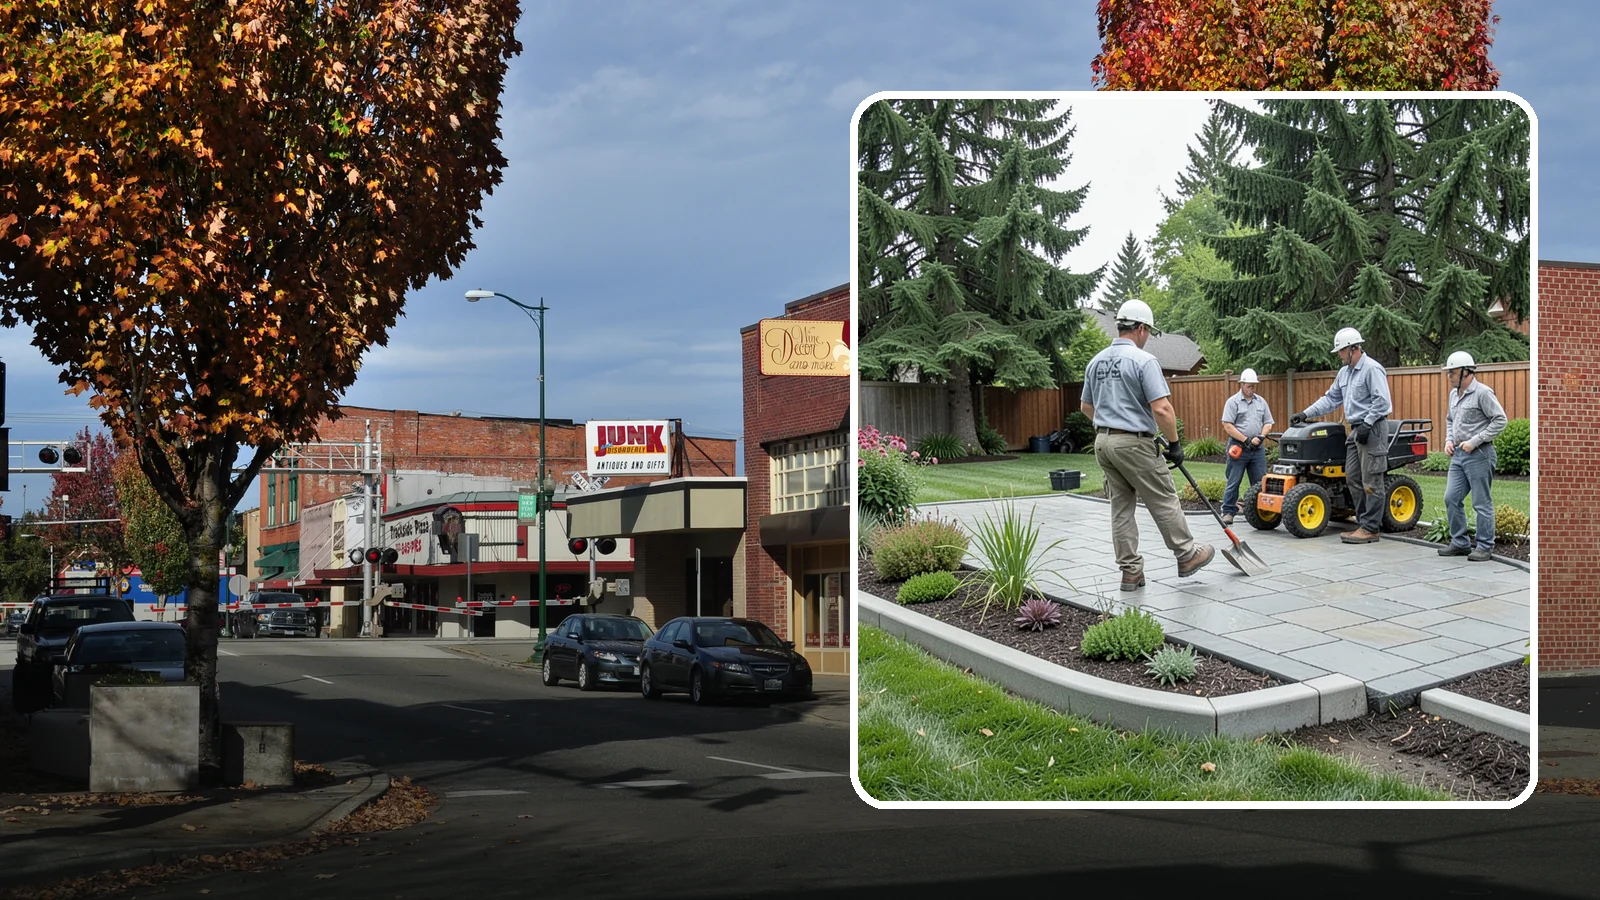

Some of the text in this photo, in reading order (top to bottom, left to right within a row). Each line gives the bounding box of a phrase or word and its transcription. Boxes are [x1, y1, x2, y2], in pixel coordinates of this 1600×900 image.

[765, 328, 830, 365] Decor
[595, 425, 665, 457] JUNK
[607, 446, 646, 454] DISORDERLY
[597, 460, 665, 470] ANTIQUES AND GIFTS
[415, 520, 429, 535] Pizza
